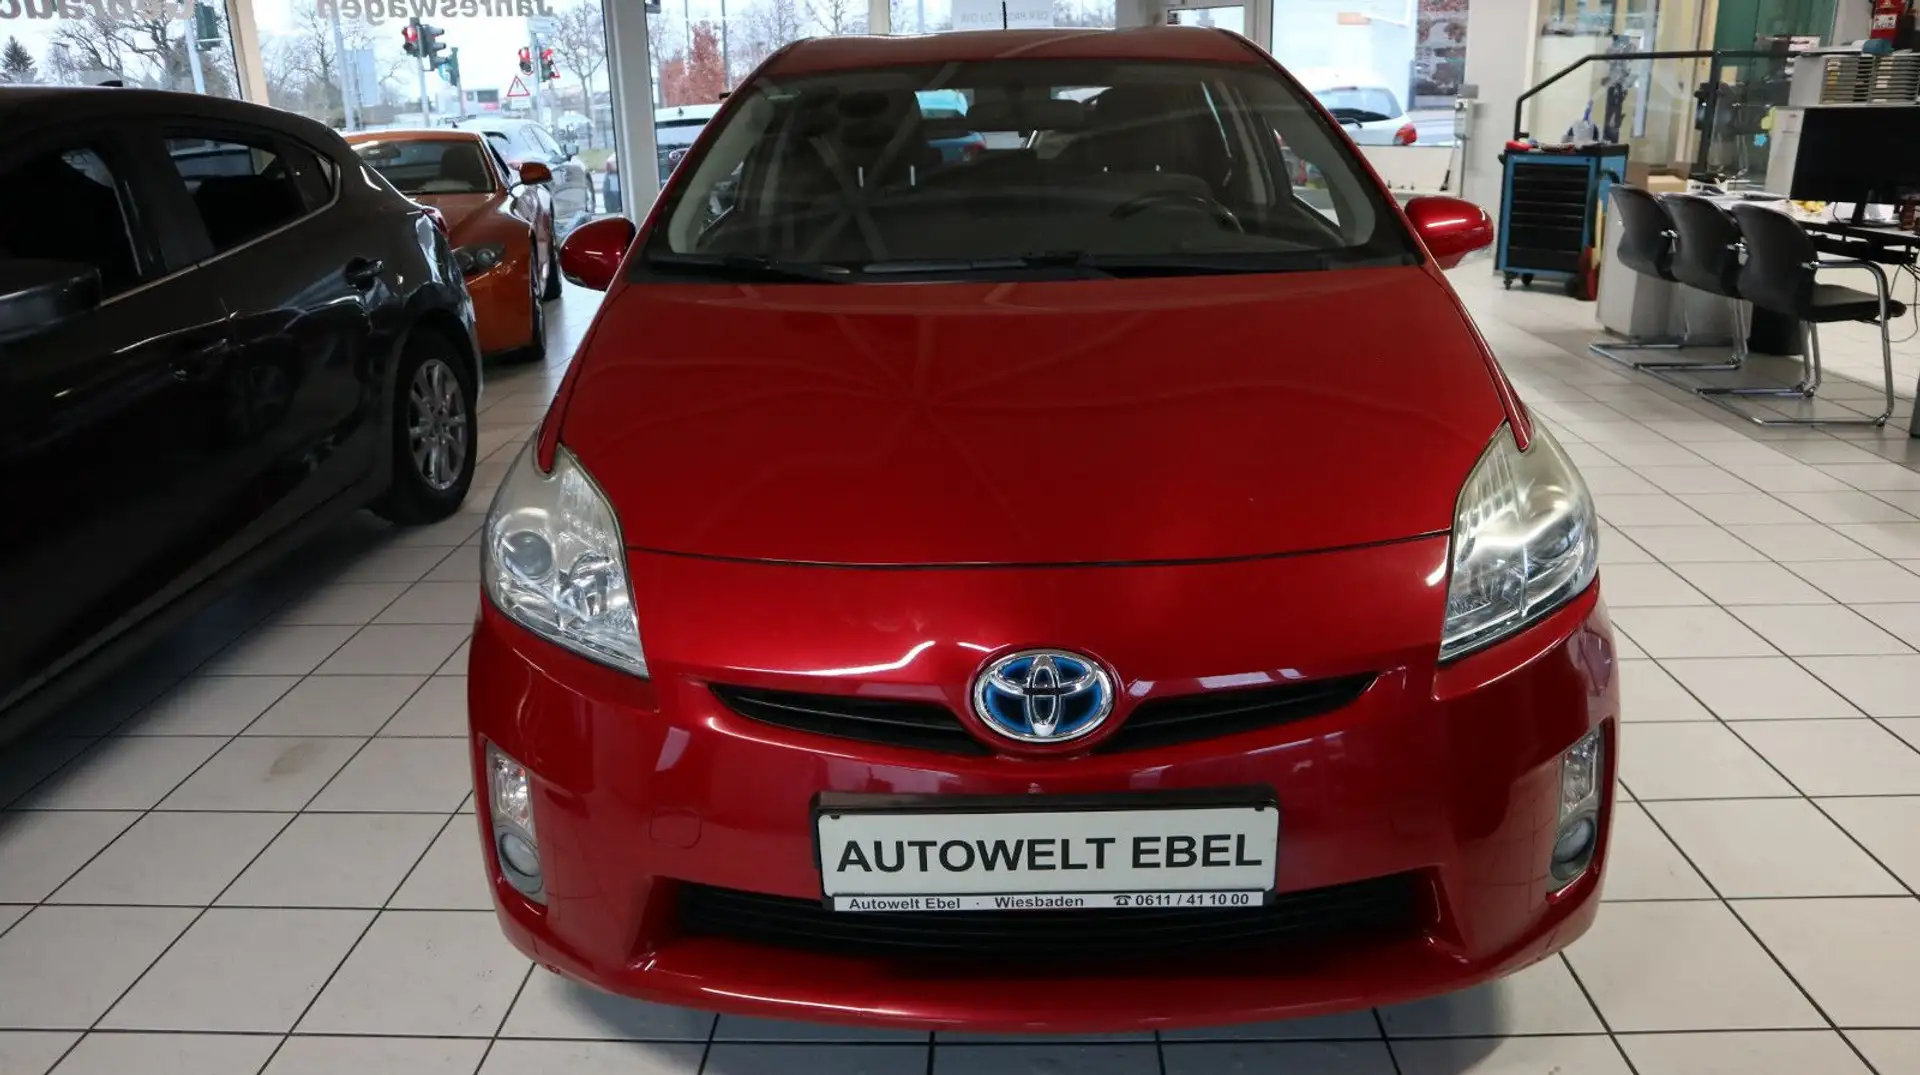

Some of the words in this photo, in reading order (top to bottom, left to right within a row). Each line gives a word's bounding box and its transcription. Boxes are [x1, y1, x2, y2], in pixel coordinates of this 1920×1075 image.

[836, 838, 1116, 873] AUTOWELT
[1132, 834, 1263, 869] EBEL
[849, 897, 920, 911] Autowelt
[925, 897, 961, 910] Ebel
[994, 895, 1084, 910] Wiesbaden
[1135, 894, 1171, 906] 0611
